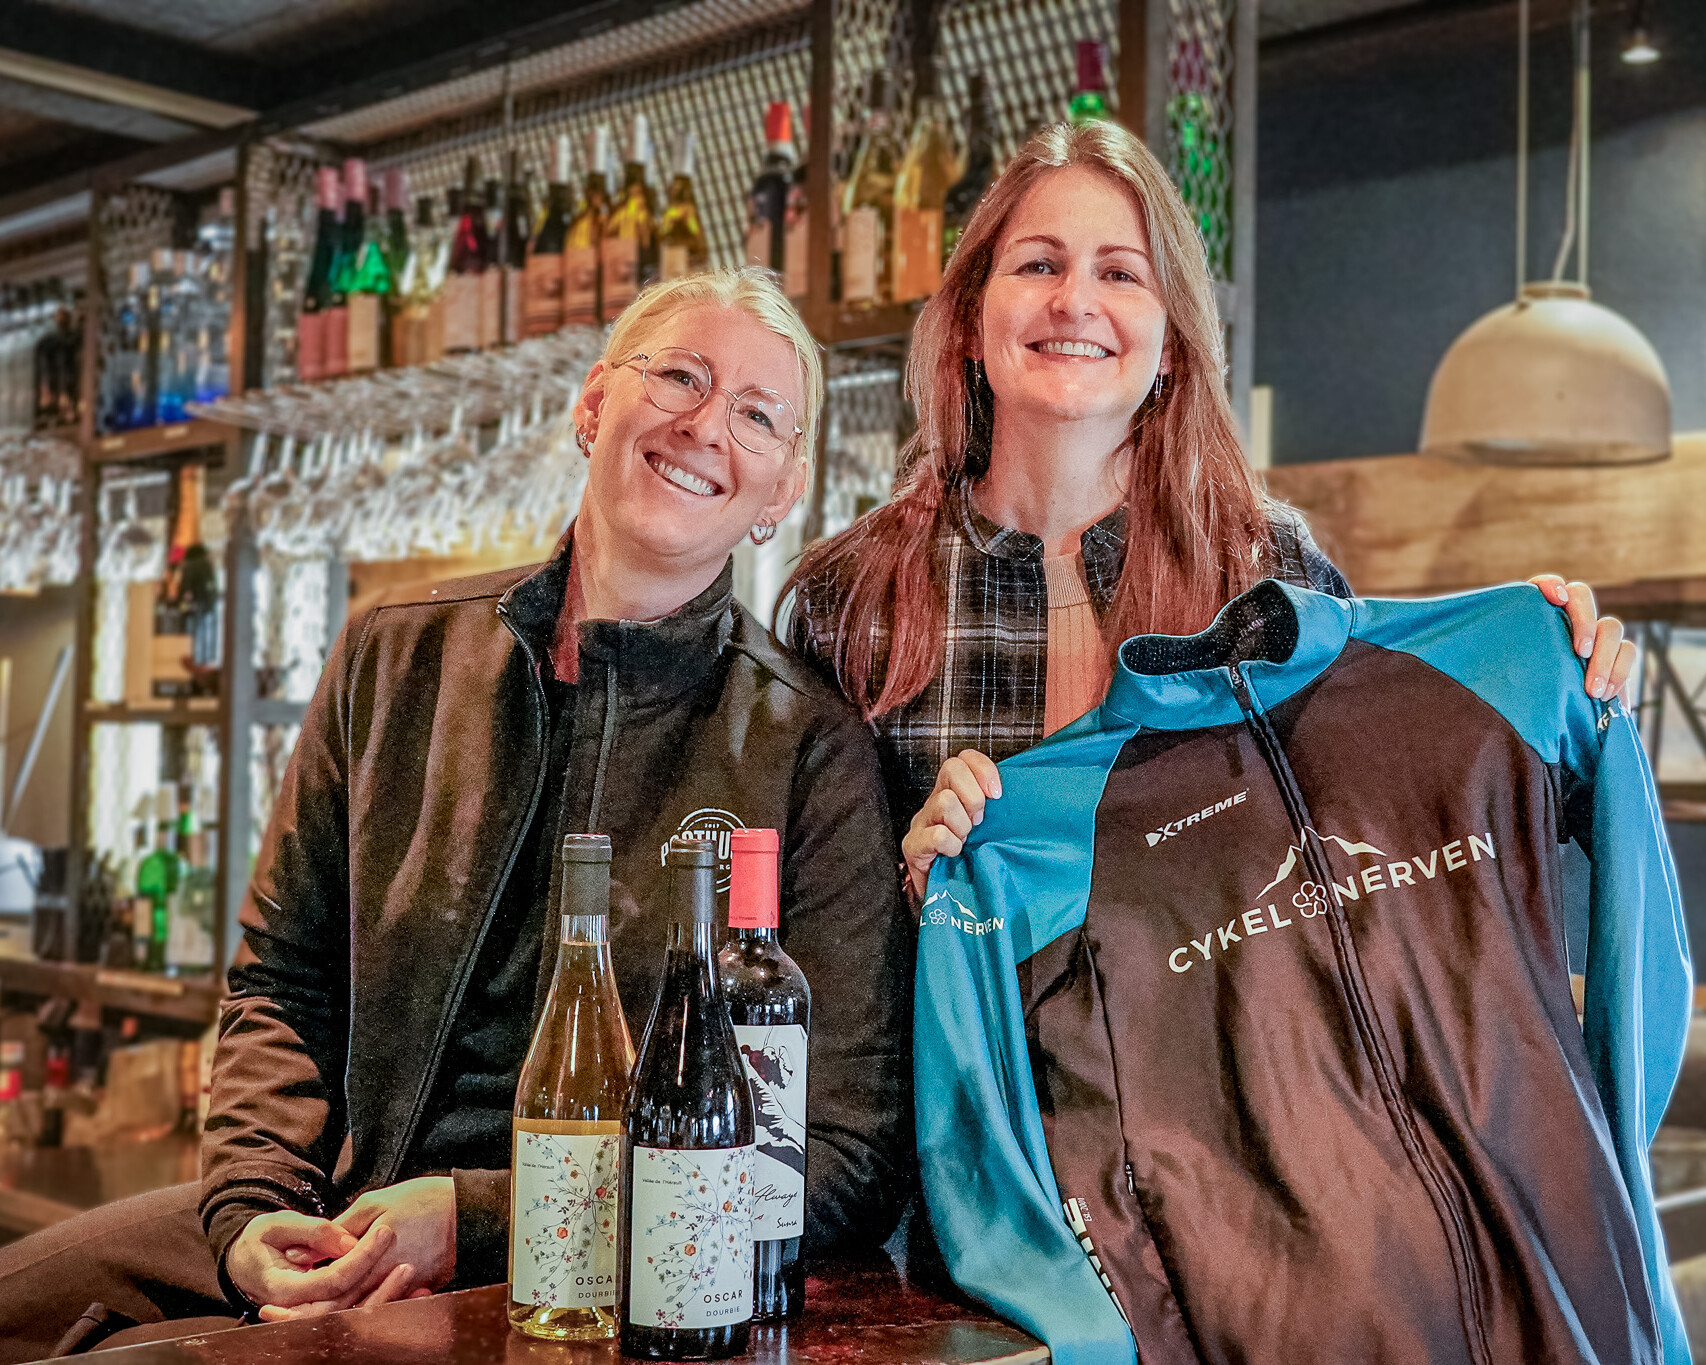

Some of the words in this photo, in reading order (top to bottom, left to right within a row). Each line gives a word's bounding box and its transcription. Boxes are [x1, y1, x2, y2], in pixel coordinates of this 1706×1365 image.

[1157, 791, 1248, 842] XTREME
[1168, 904, 1292, 974] CYKEL
[1332, 832, 1496, 907] NERVEN
[575, 1275, 613, 1286] OSCA
[703, 1289, 743, 1304] OSCAR
[706, 1307, 741, 1317] DOURBIE
